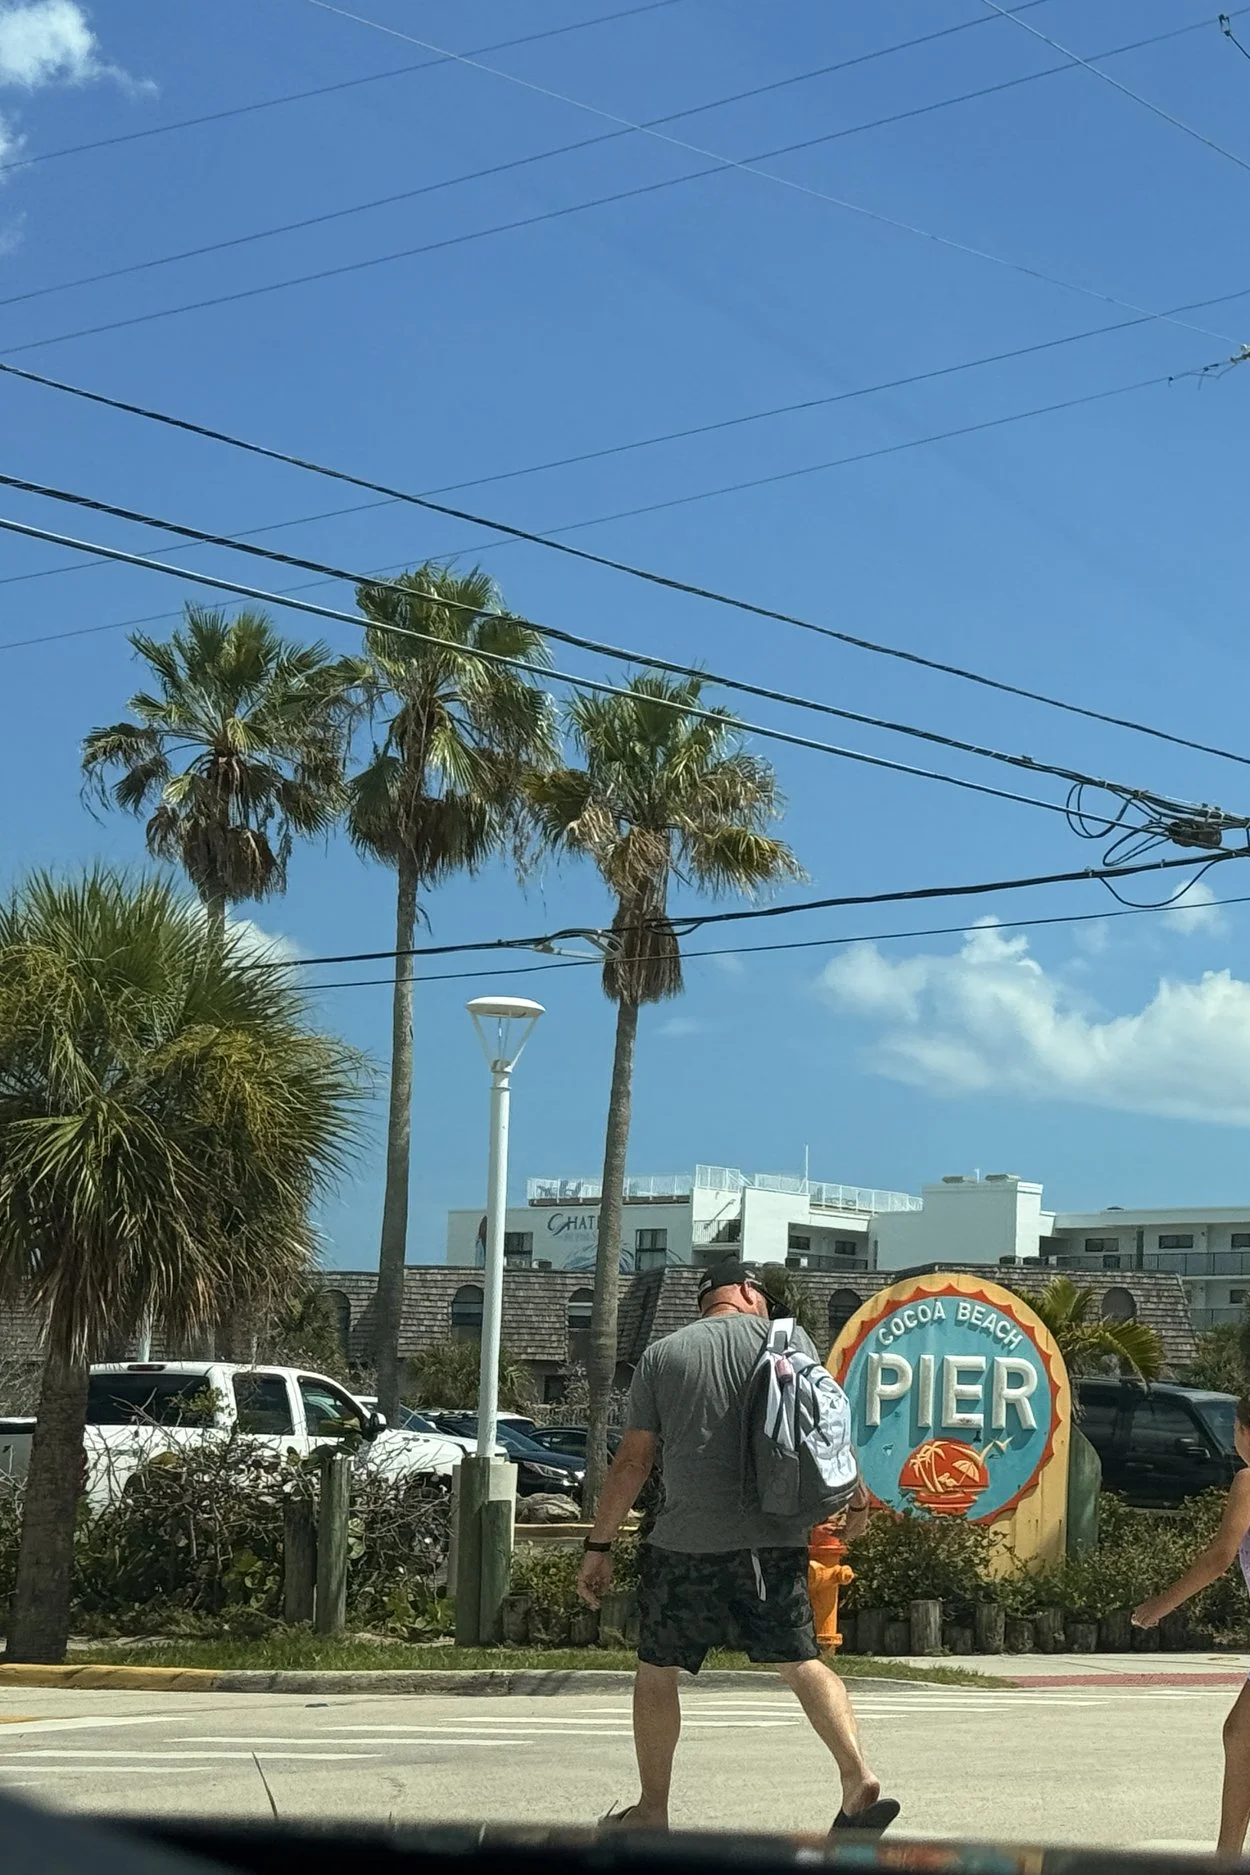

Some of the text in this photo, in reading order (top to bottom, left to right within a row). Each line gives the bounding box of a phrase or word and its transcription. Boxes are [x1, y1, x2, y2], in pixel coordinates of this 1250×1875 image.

[547, 1213, 600, 1236] CHAT
[878, 1301, 1023, 1350] COCOA BEACH
[865, 1352, 1038, 1430] PIER
